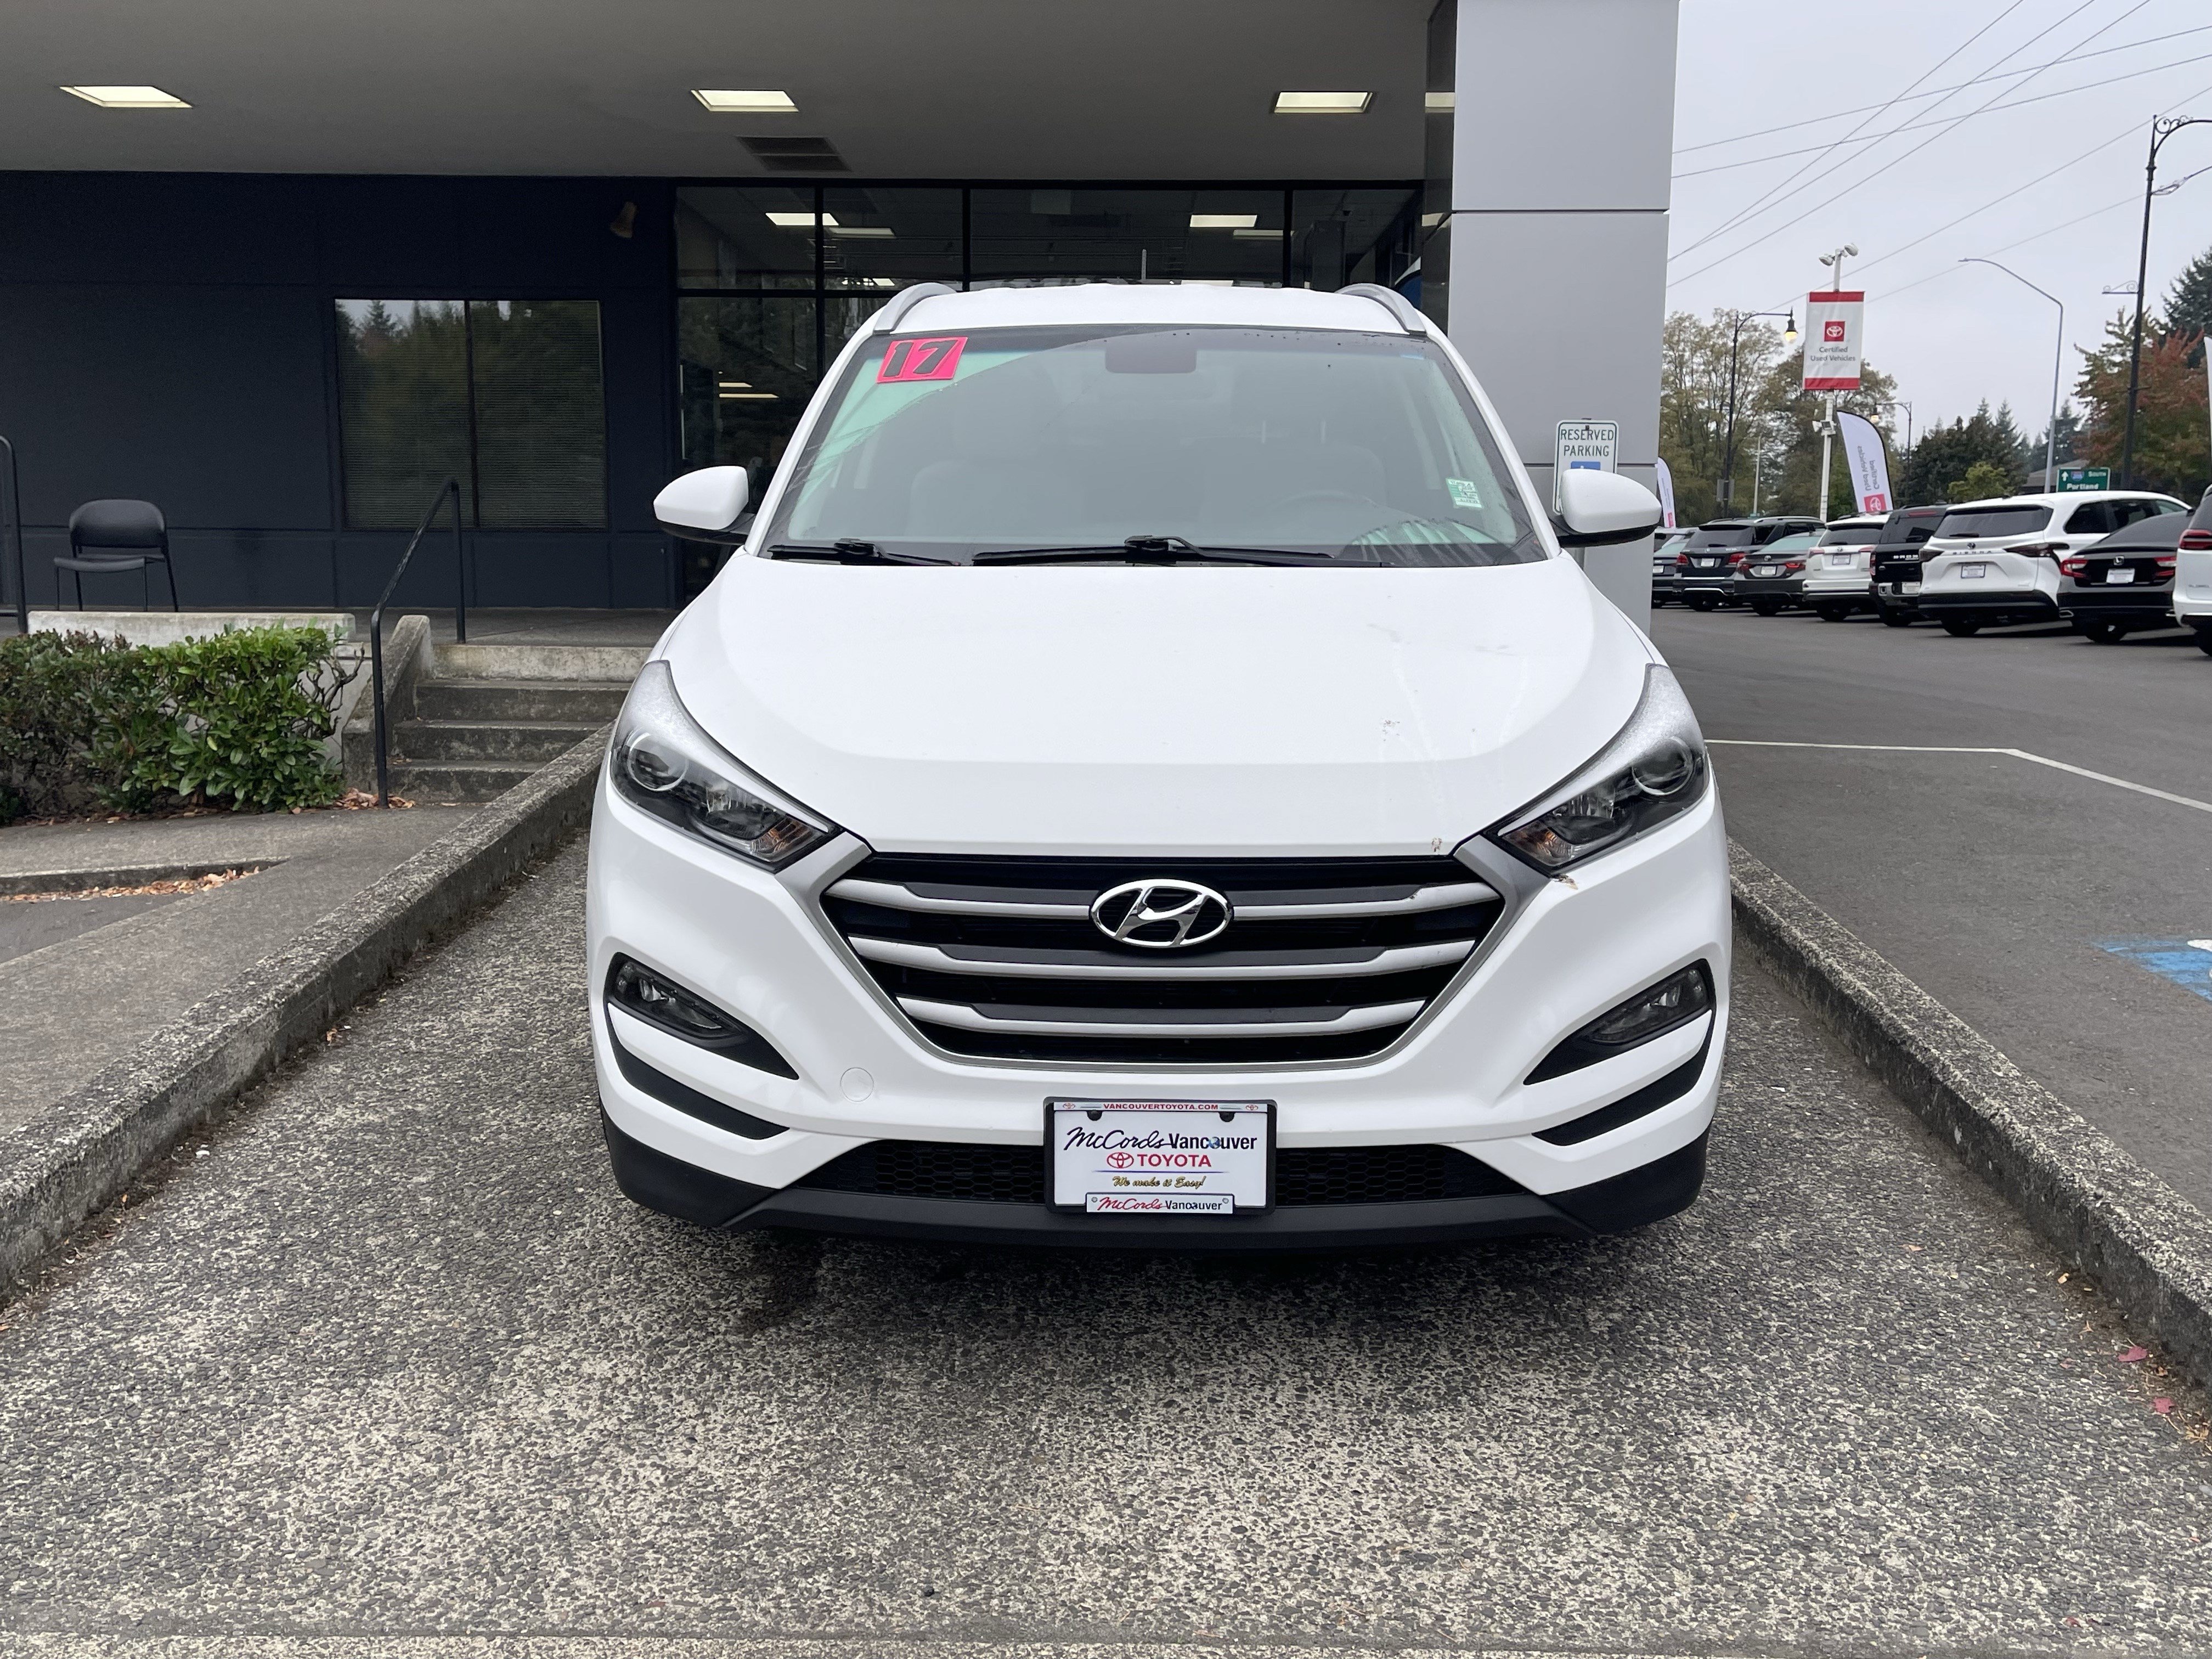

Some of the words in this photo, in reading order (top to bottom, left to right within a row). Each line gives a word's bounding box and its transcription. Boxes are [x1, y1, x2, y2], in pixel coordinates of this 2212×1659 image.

[883, 340, 959, 377] 17
[1561, 429, 1614, 441] RESERVED
[1564, 445, 1609, 457] PARKING
[1138, 1154, 1212, 1167] TOYOTA
[1174, 1176, 1207, 1189] Easy!
